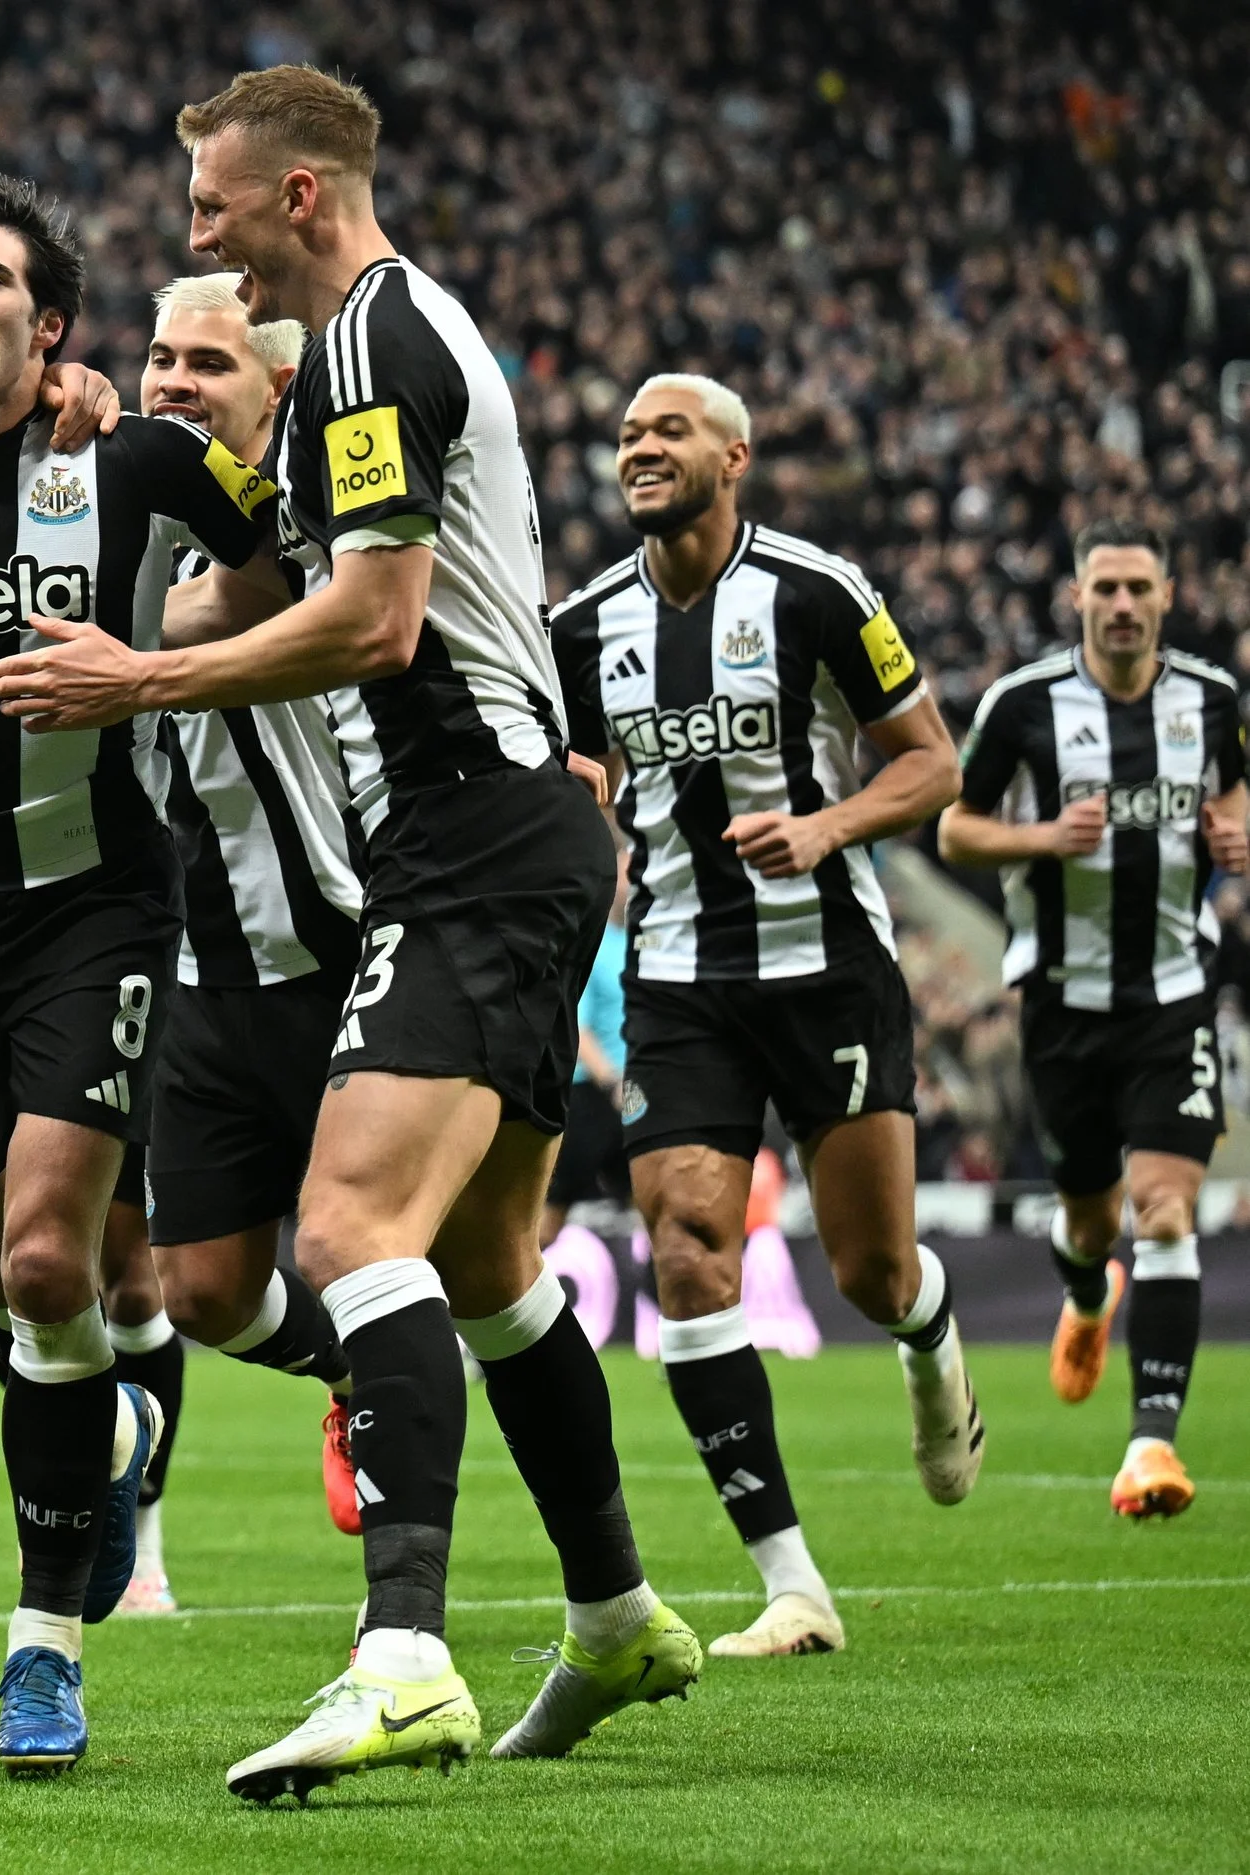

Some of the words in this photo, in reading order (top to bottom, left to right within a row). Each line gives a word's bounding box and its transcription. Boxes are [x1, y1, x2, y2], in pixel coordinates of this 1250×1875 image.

[238, 475, 267, 508] no
[336, 462, 397, 497] noon
[659, 699, 770, 758] sela
[1110, 781, 1194, 824] sela
[341, 923, 405, 1019] 3
[112, 974, 152, 1060] 8
[1191, 1026, 1217, 1088] 5
[832, 1043, 869, 1117] 7
[347, 1409, 375, 1443] FC
[693, 1421, 750, 1453] UFC
[18, 1495, 92, 1530] NUFC
